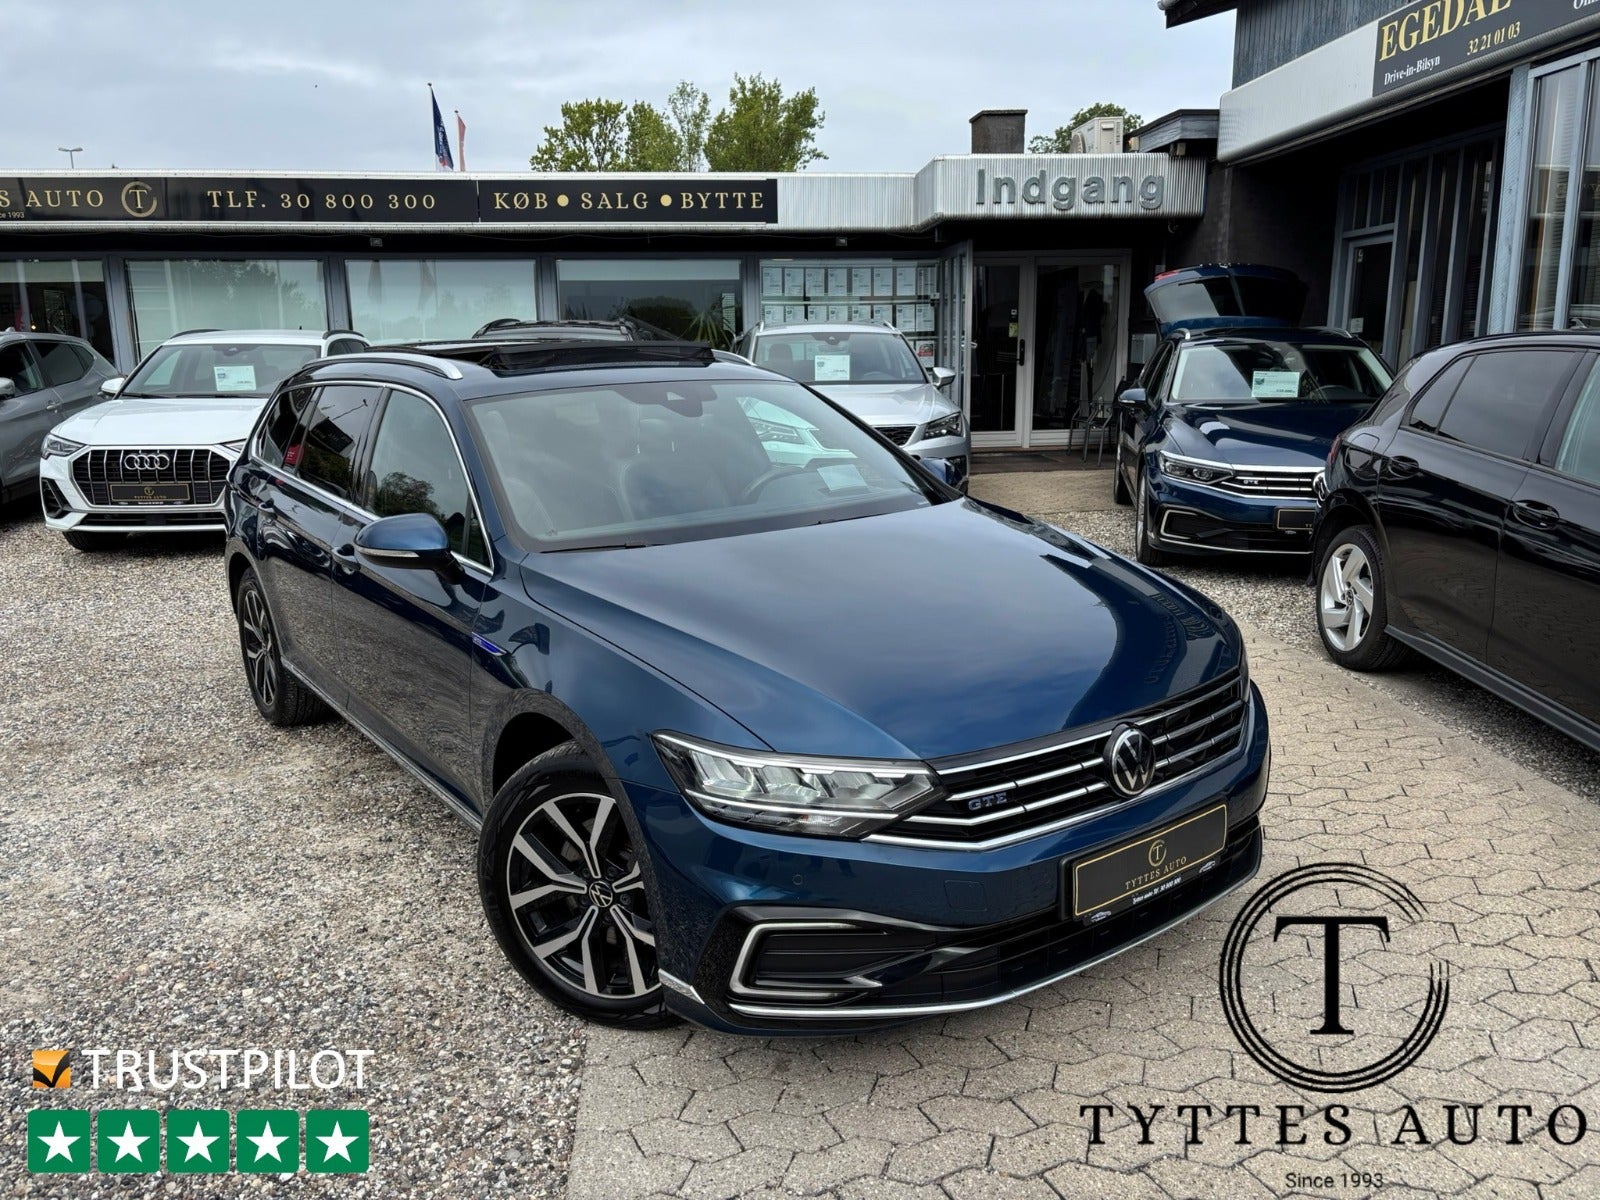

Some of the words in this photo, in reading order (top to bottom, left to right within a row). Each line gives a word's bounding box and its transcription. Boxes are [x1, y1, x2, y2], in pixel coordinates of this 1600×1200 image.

[1467, 38, 1479, 56] 32
[1480, 33, 1491, 50] 21
[1494, 28, 1505, 45] 01
[1508, 21, 1520, 40] 03
[1384, 55, 1440, 85] Drive-in-Bilsyn
[976, 168, 1165, 210] Indgang
[26, 190, 104, 208] AUTO
[208, 190, 267, 208] TLF.
[280, 193, 310, 209] 30
[325, 194, 374, 209] 800
[388, 194, 435, 209] 300
[494, 192, 548, 210] KØB
[581, 192, 649, 210] SALG
[681, 192, 764, 209] BYTTE
[8, 211, 25, 219] 1993
[968, 792, 1008, 811] GTE
[1125, 868, 1161, 890] TYTTES
[1163, 856, 1187, 874] AUTO
